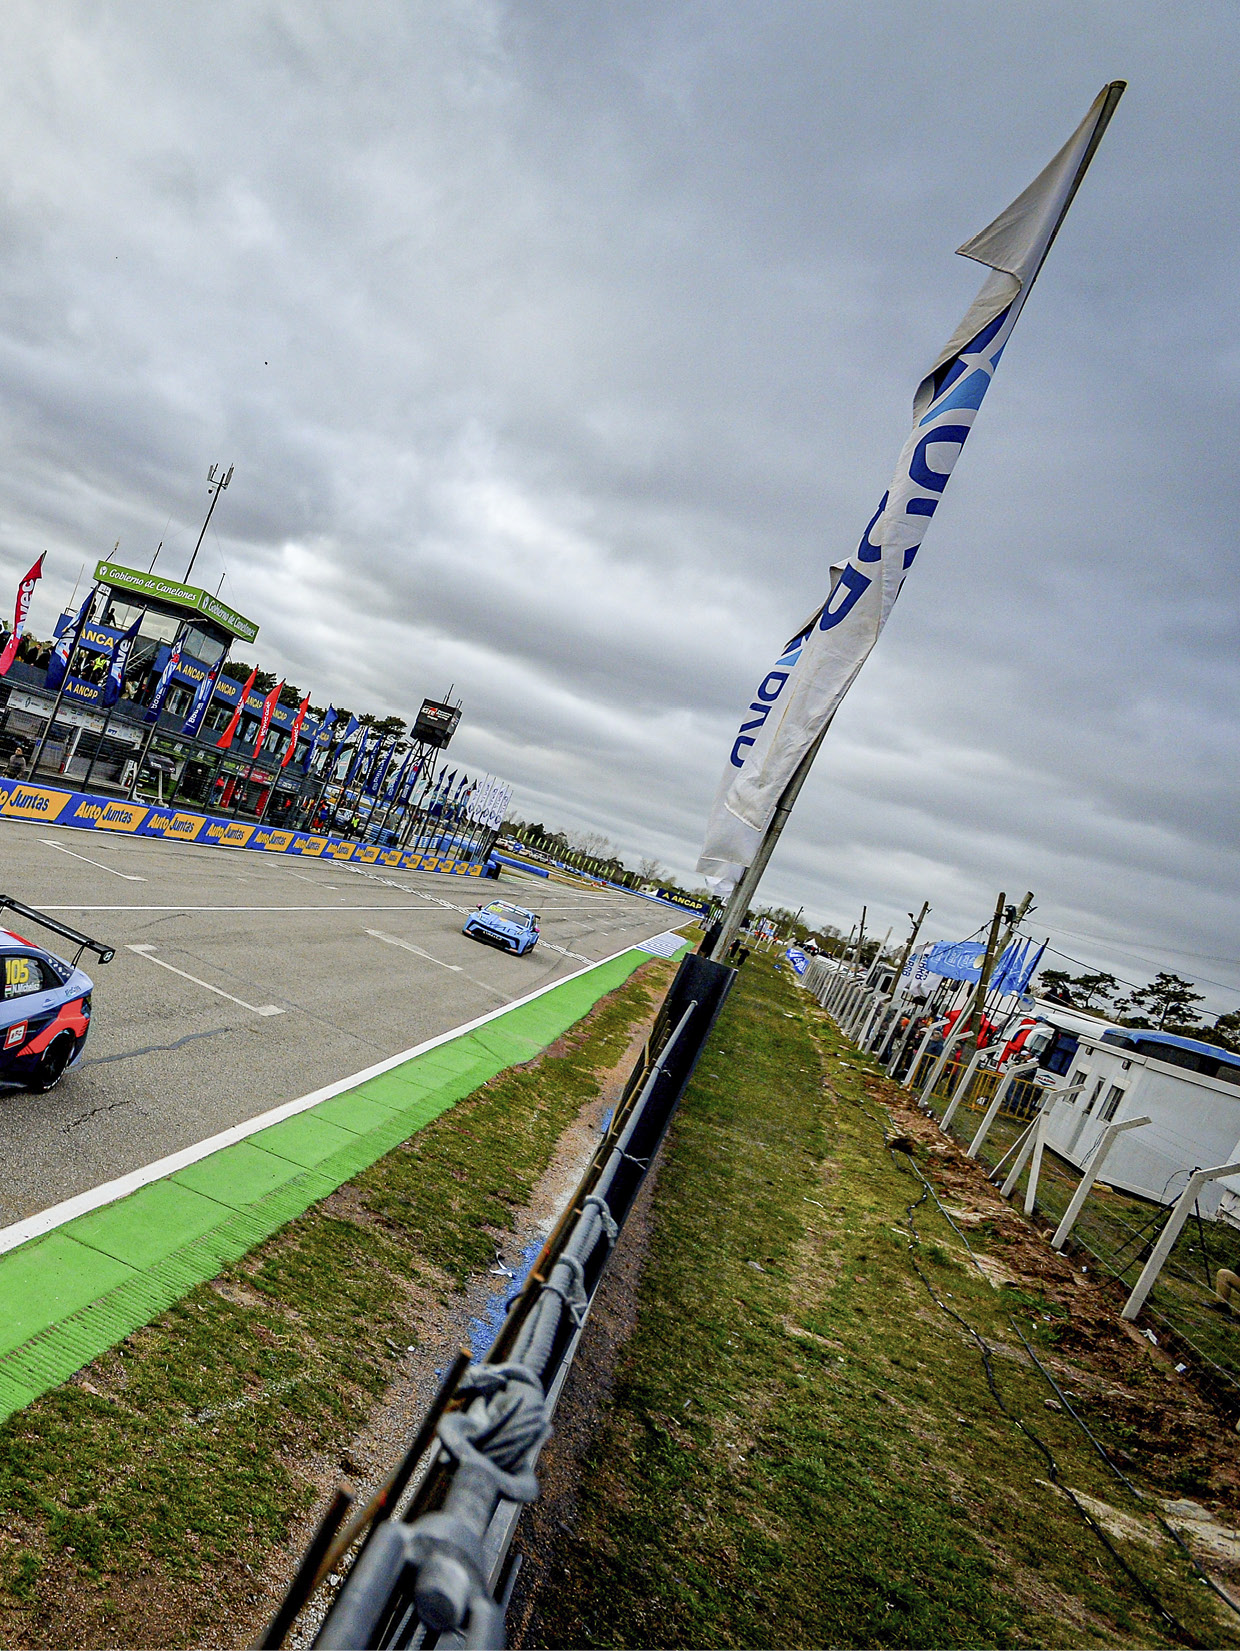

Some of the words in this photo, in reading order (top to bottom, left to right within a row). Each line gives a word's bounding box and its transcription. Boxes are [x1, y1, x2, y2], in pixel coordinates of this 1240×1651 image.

[109, 568, 144, 586] Gobierno
[145, 578, 155, 589] de
[156, 582, 197, 601] Canelones
[81, 628, 117, 649] ANCA
[182, 664, 205, 681] ANCAP
[74, 686, 99, 700] ANCAP
[216, 681, 237, 697] ANCAP
[671, 894, 703, 910] ANCAP
[5, 958, 30, 985] 105
